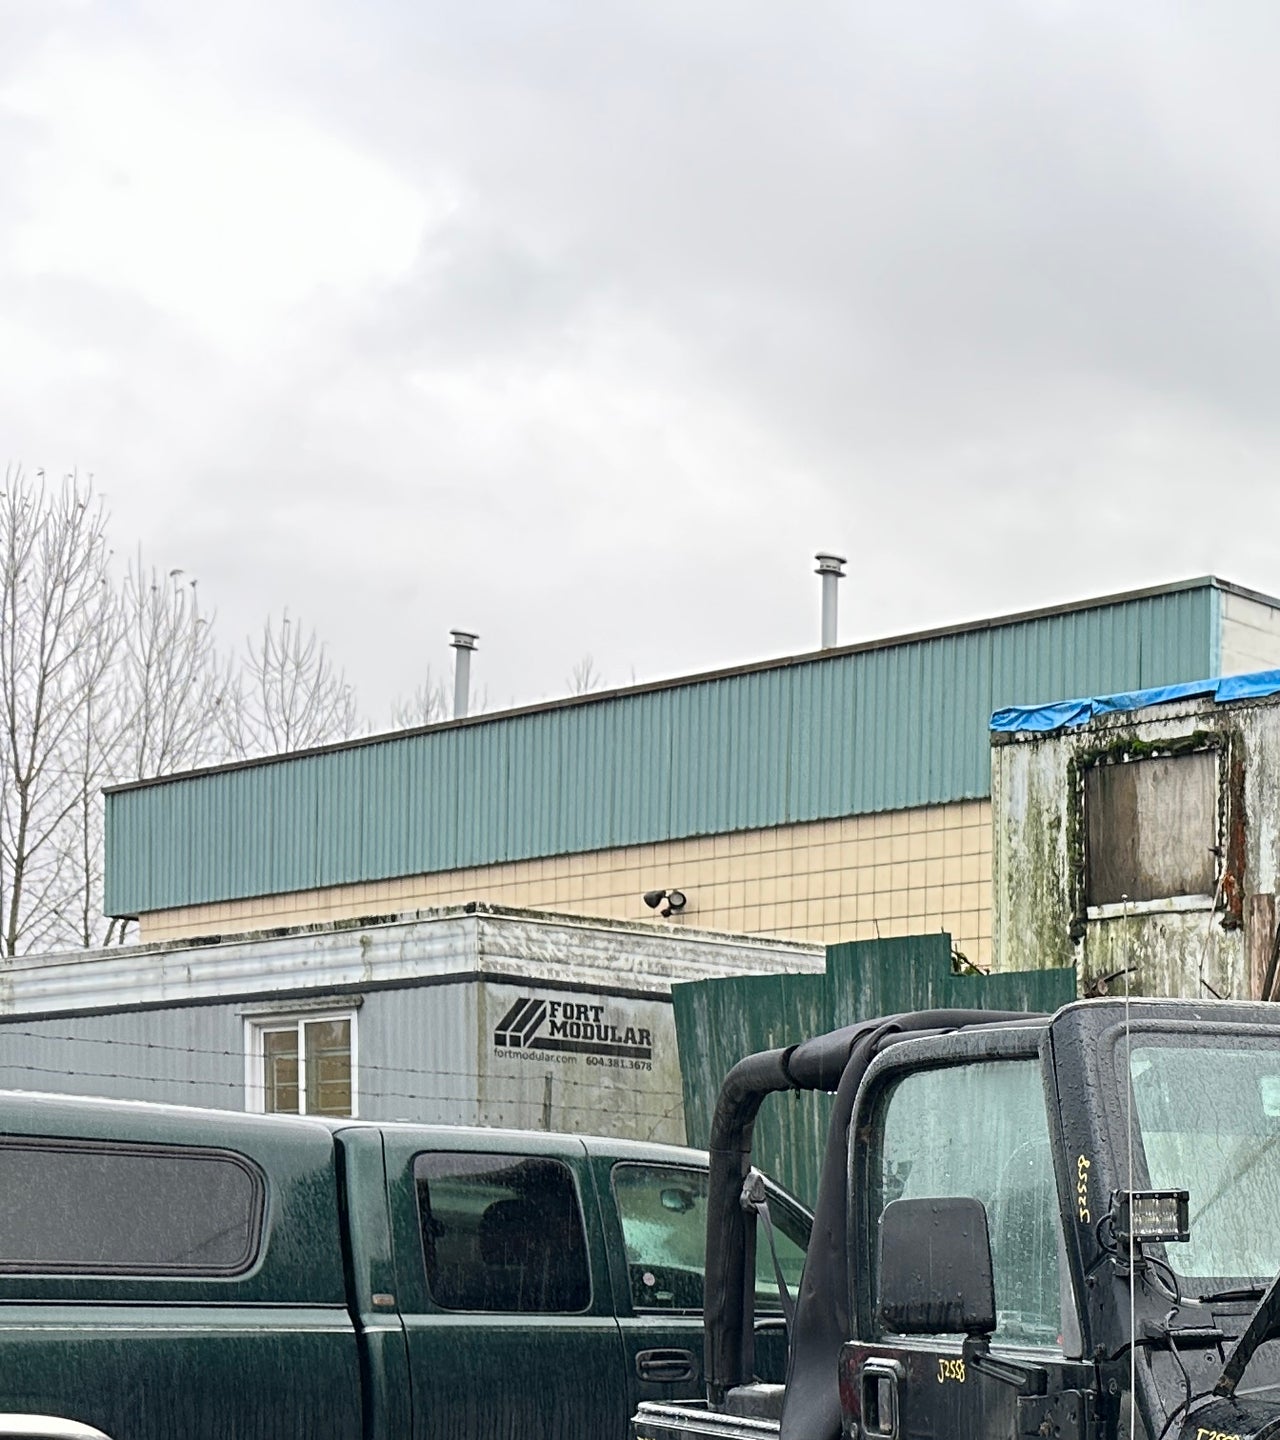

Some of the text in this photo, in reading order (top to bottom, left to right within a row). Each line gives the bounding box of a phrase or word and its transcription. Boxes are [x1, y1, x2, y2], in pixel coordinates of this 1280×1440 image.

[548, 1000, 605, 1023] FORT
[548, 1019, 652, 1046] MODULAR
[493, 1047, 652, 1072] fortmodular.com 604.381.3678
